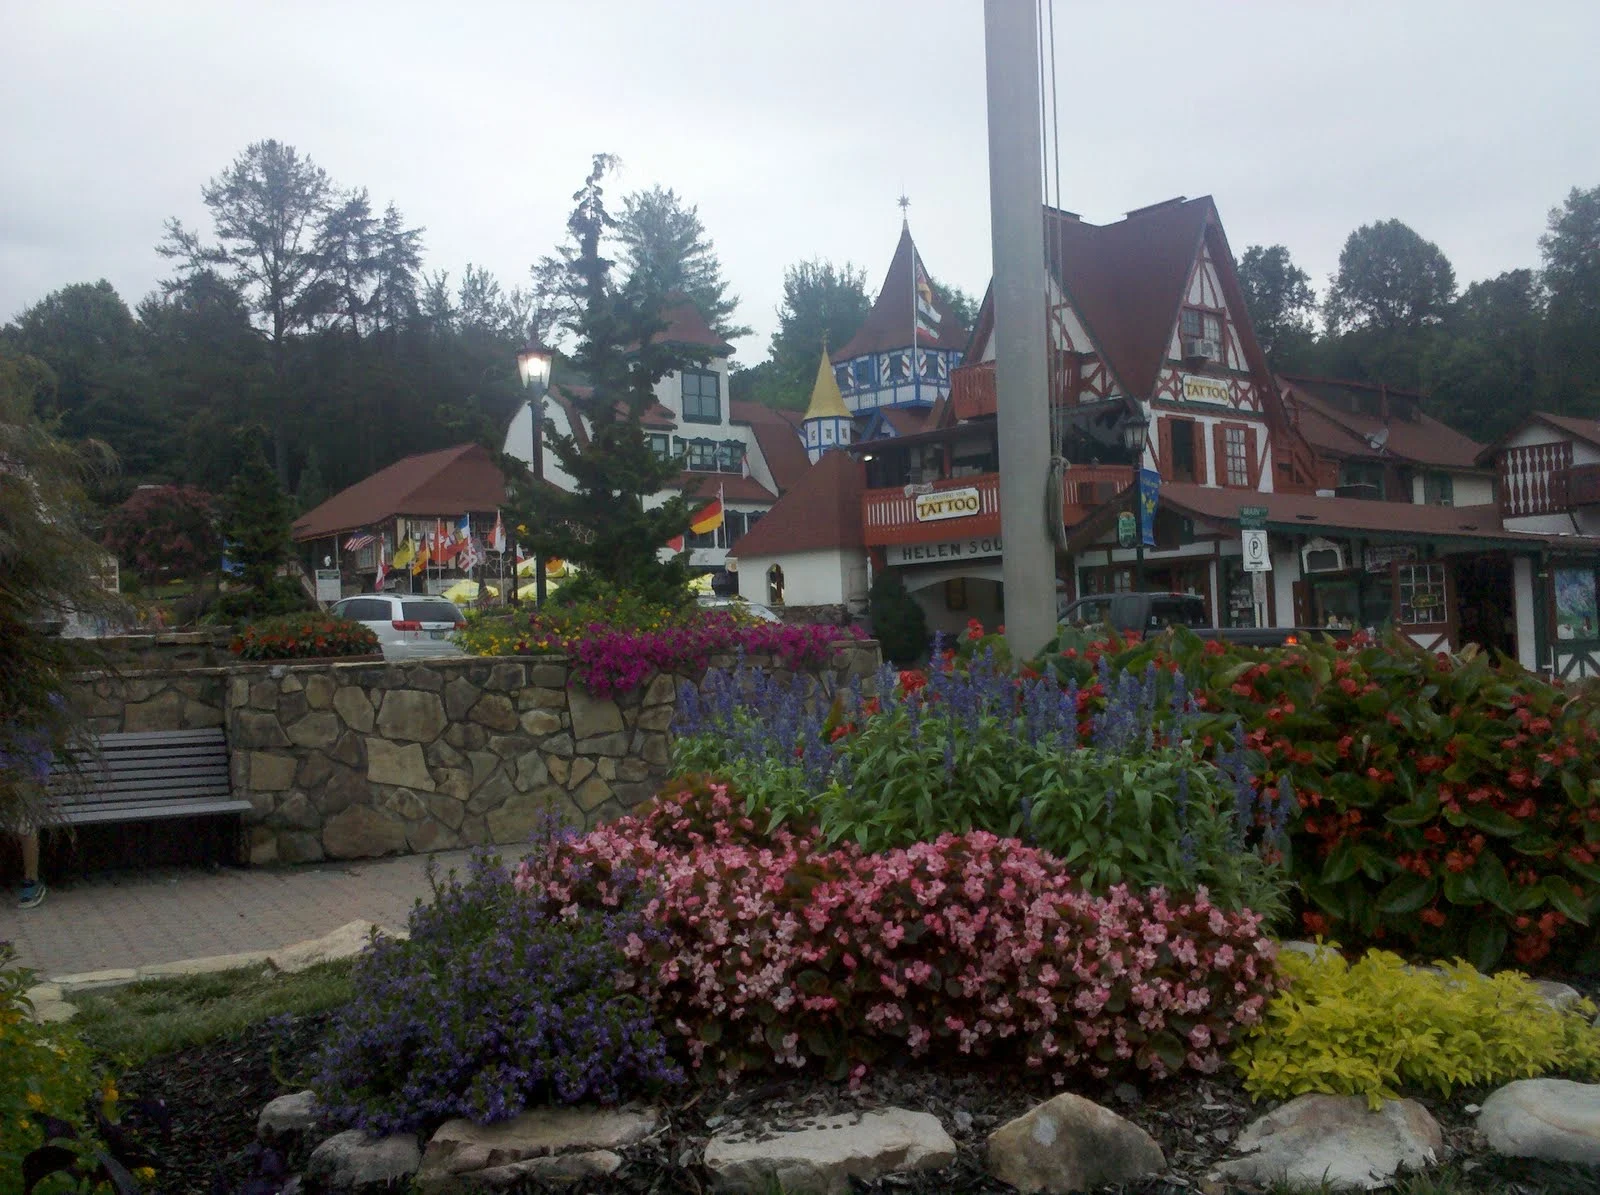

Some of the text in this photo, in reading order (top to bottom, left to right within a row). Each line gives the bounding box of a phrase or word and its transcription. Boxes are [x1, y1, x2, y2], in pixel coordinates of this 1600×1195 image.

[1185, 383, 1228, 401] TATTOO
[918, 497, 978, 518] TATTOO
[902, 538, 1003, 560] HELEN SQU
